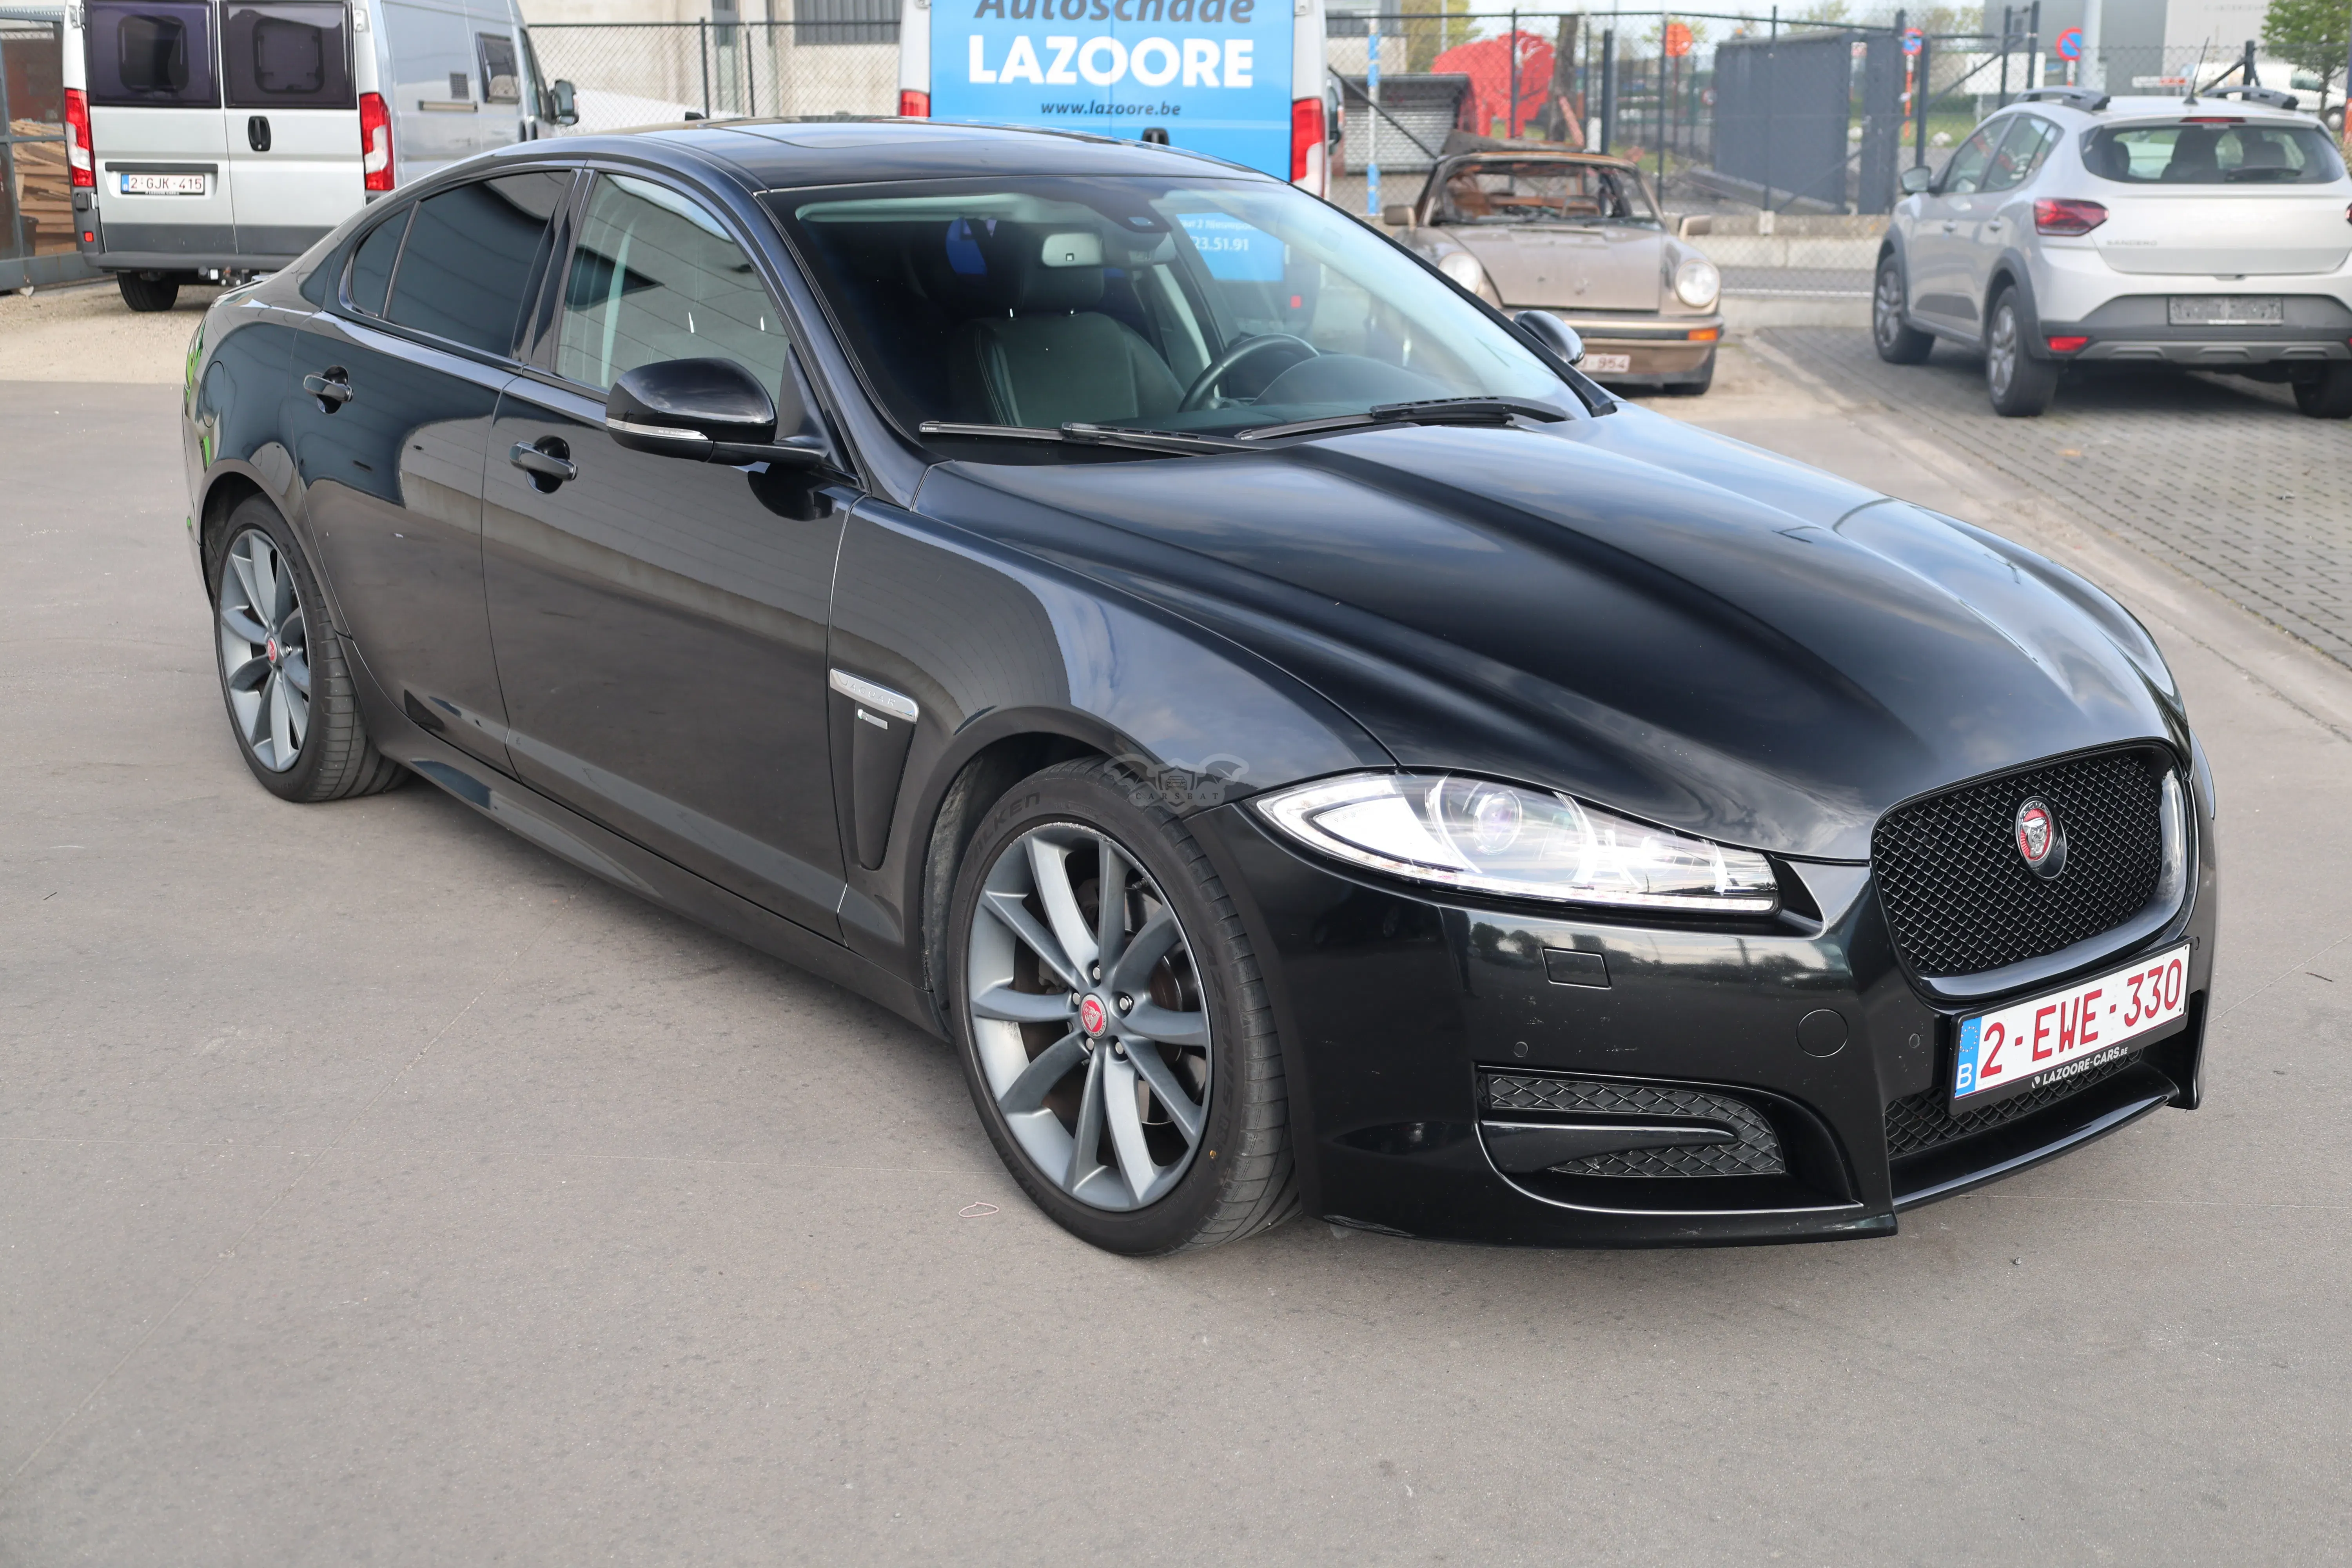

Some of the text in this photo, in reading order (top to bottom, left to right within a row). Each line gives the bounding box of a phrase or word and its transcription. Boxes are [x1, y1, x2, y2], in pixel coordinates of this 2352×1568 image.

[973, 0, 1254, 23] Autoschade
[969, 34, 1254, 88] LAZOORE
[1041, 100, 1181, 116] www.lazoore.be
[842, 680, 896, 706] JAGUAR
[1980, 958, 2182, 1079] 2-EWE-330
[1956, 1063, 1973, 1089] B
[2042, 1046, 2128, 1085] LAZOORE-CARS.BE
